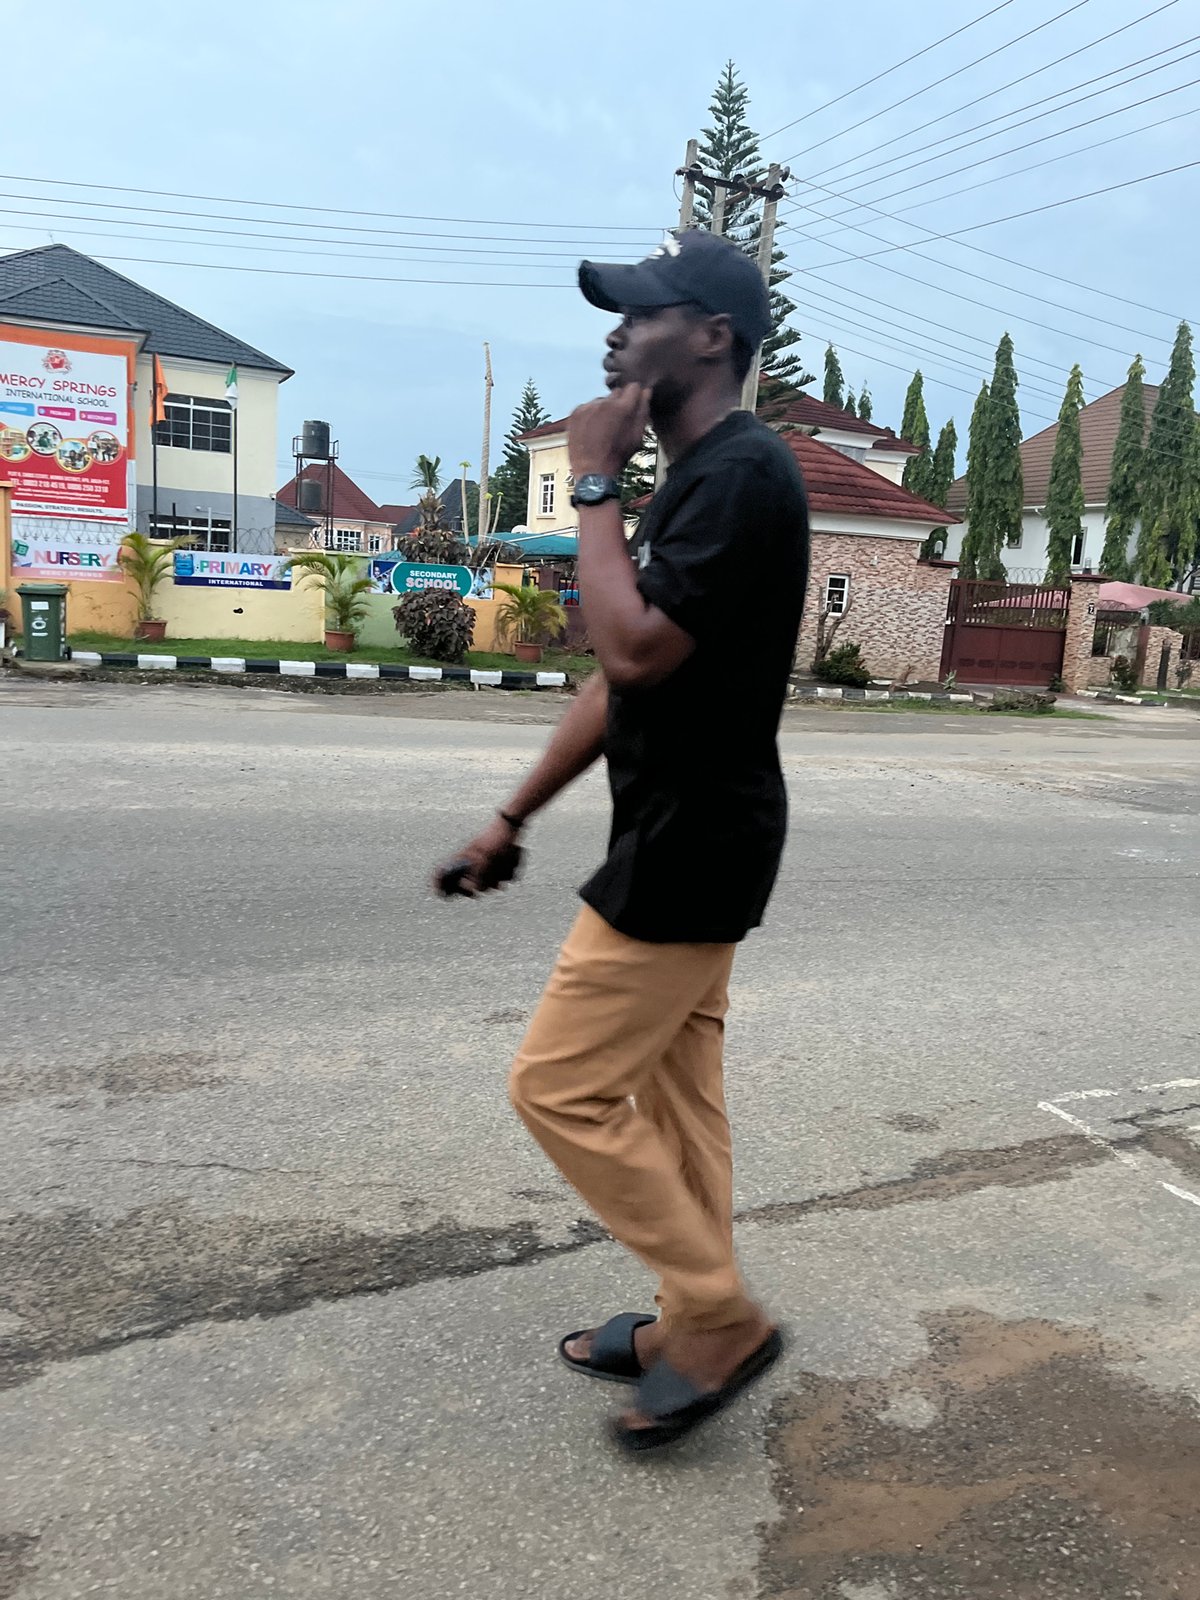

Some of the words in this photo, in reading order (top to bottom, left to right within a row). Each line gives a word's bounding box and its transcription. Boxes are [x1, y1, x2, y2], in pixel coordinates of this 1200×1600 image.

[0, 374, 45, 388] MERCY
[53, 380, 117, 397] SPRINGS
[5, 388, 74, 404] INTERNATIONAL
[77, 397, 109, 408] SCHOOL
[34, 550, 111, 567] NURSERY
[200, 560, 272, 576] PRIMARY
[410, 570, 457, 579] SECONDARY
[208, 579, 264, 587] INTERNATIONAL
[406, 577, 461, 590] SCHOOL
